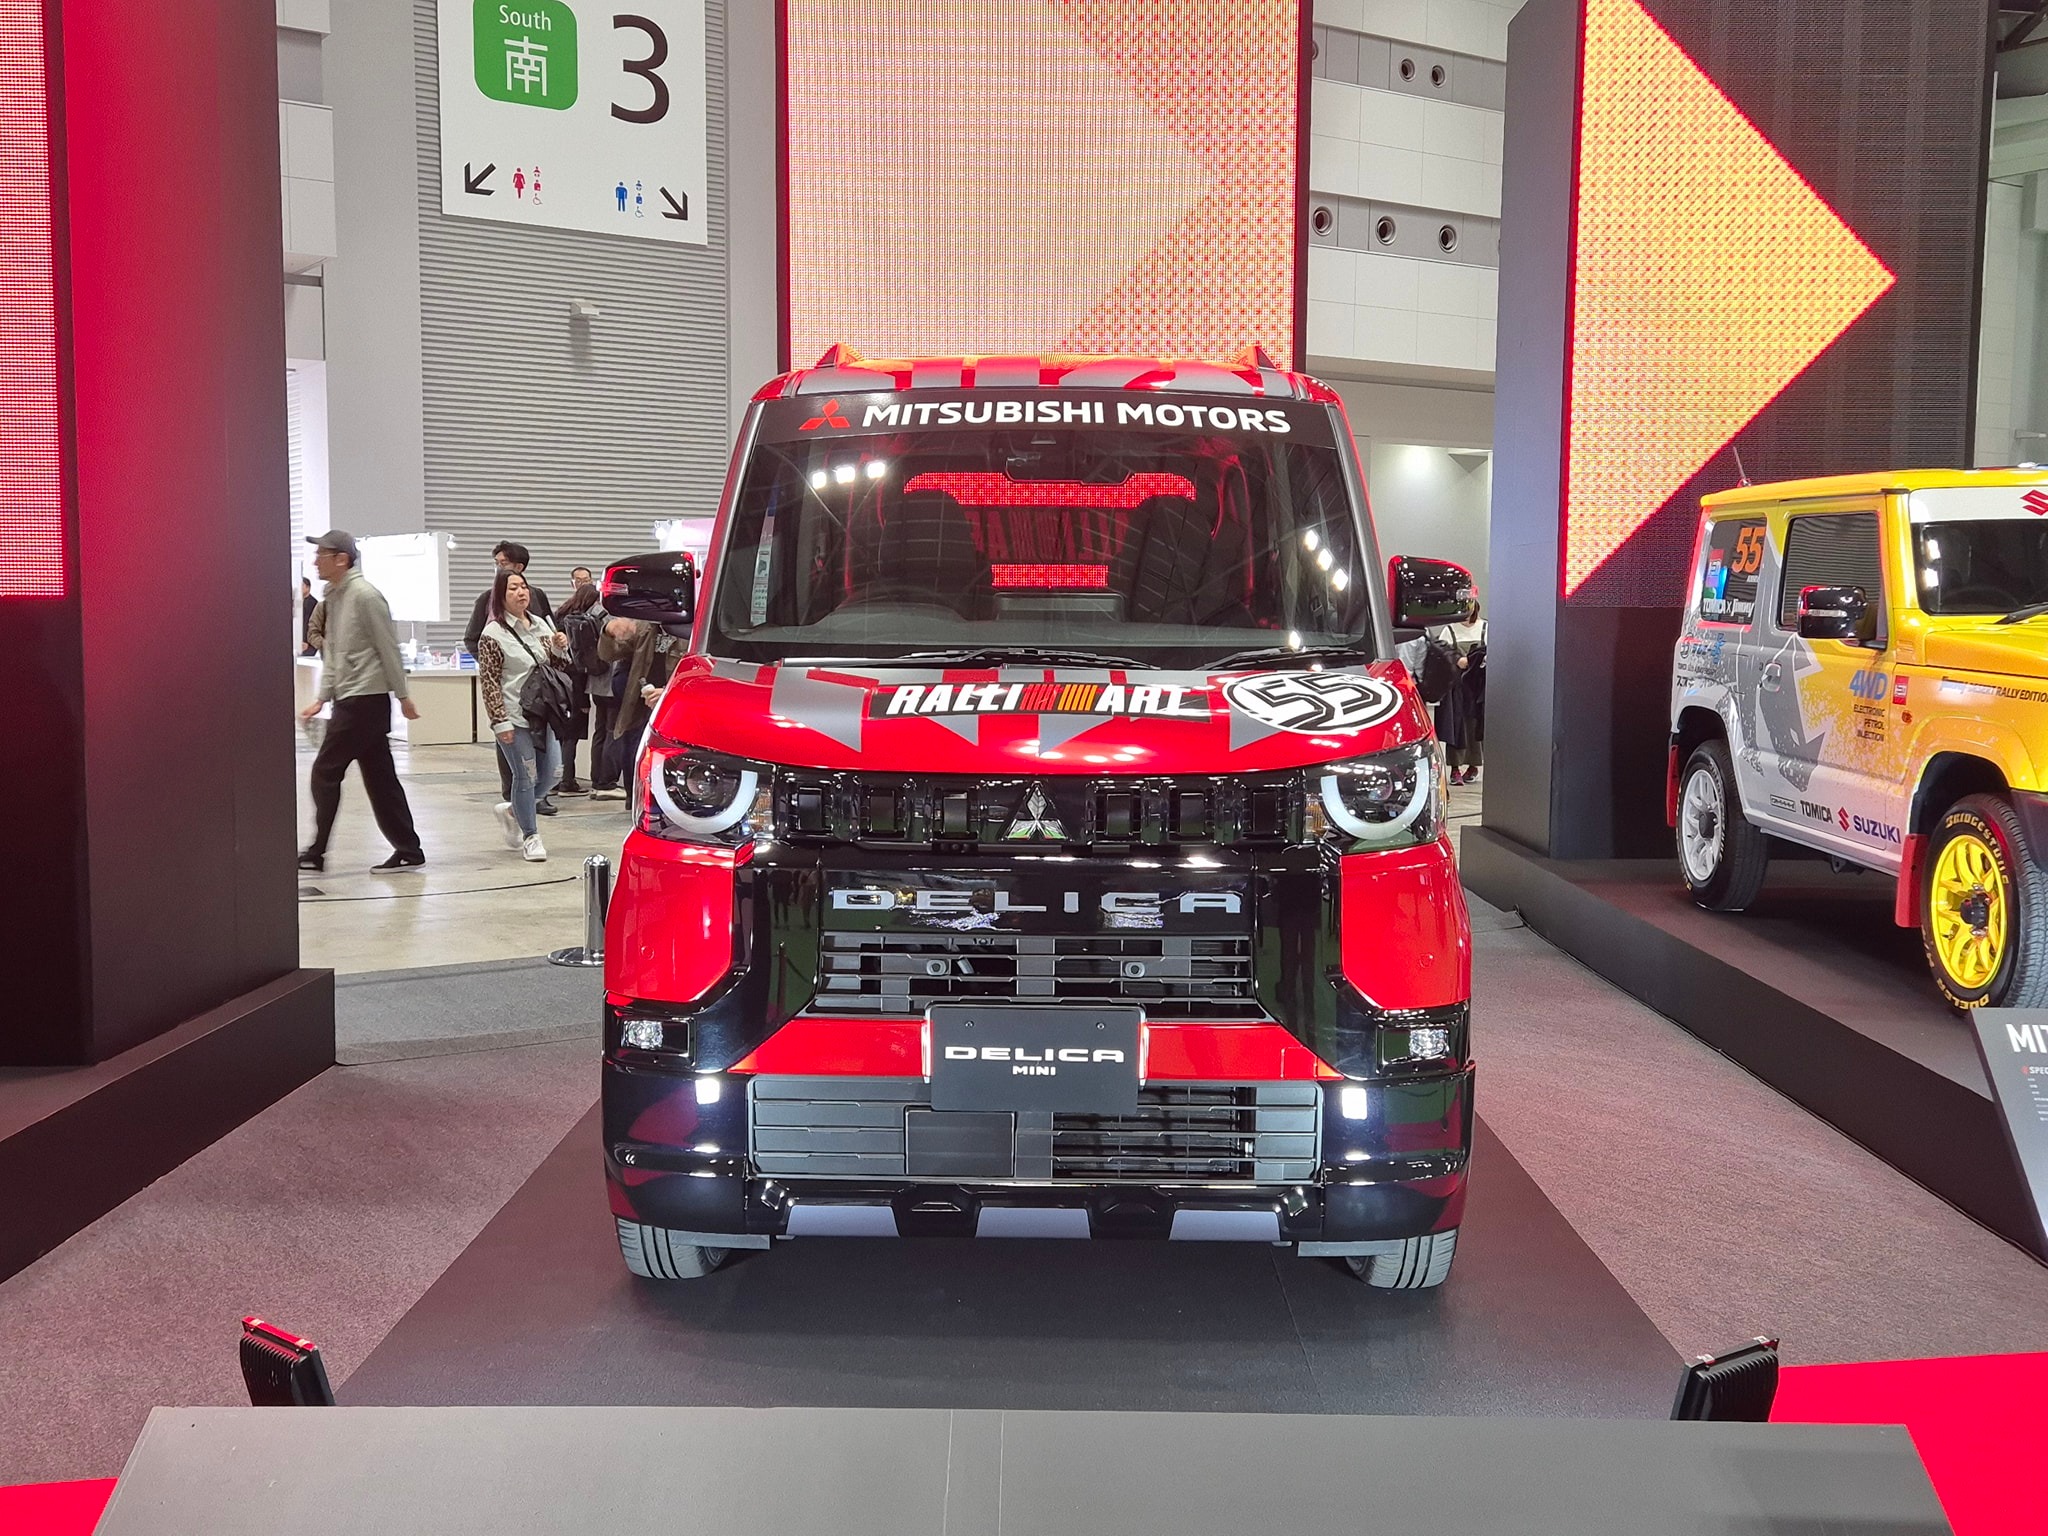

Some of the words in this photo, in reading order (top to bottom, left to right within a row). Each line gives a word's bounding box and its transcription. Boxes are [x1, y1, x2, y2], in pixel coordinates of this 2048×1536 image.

[499, 4, 551, 31] South
[504, 35, 549, 96] 南
[611, 14, 670, 124] 3
[862, 401, 1103, 427] MITSUBISHI
[1117, 402, 1291, 433] MOTORS
[1732, 527, 1766, 573] 55
[886, 683, 1020, 714] RALLI
[1849, 670, 1887, 700] 4WD
[2020, 689, 2048, 703] EDITIO
[1800, 800, 1833, 824] TOMICA
[1852, 814, 1901, 844] SUZUKI
[832, 889, 1241, 914] DELICA
[944, 1045, 1125, 1063] DELICA
[1012, 1065, 1057, 1077] MINI
